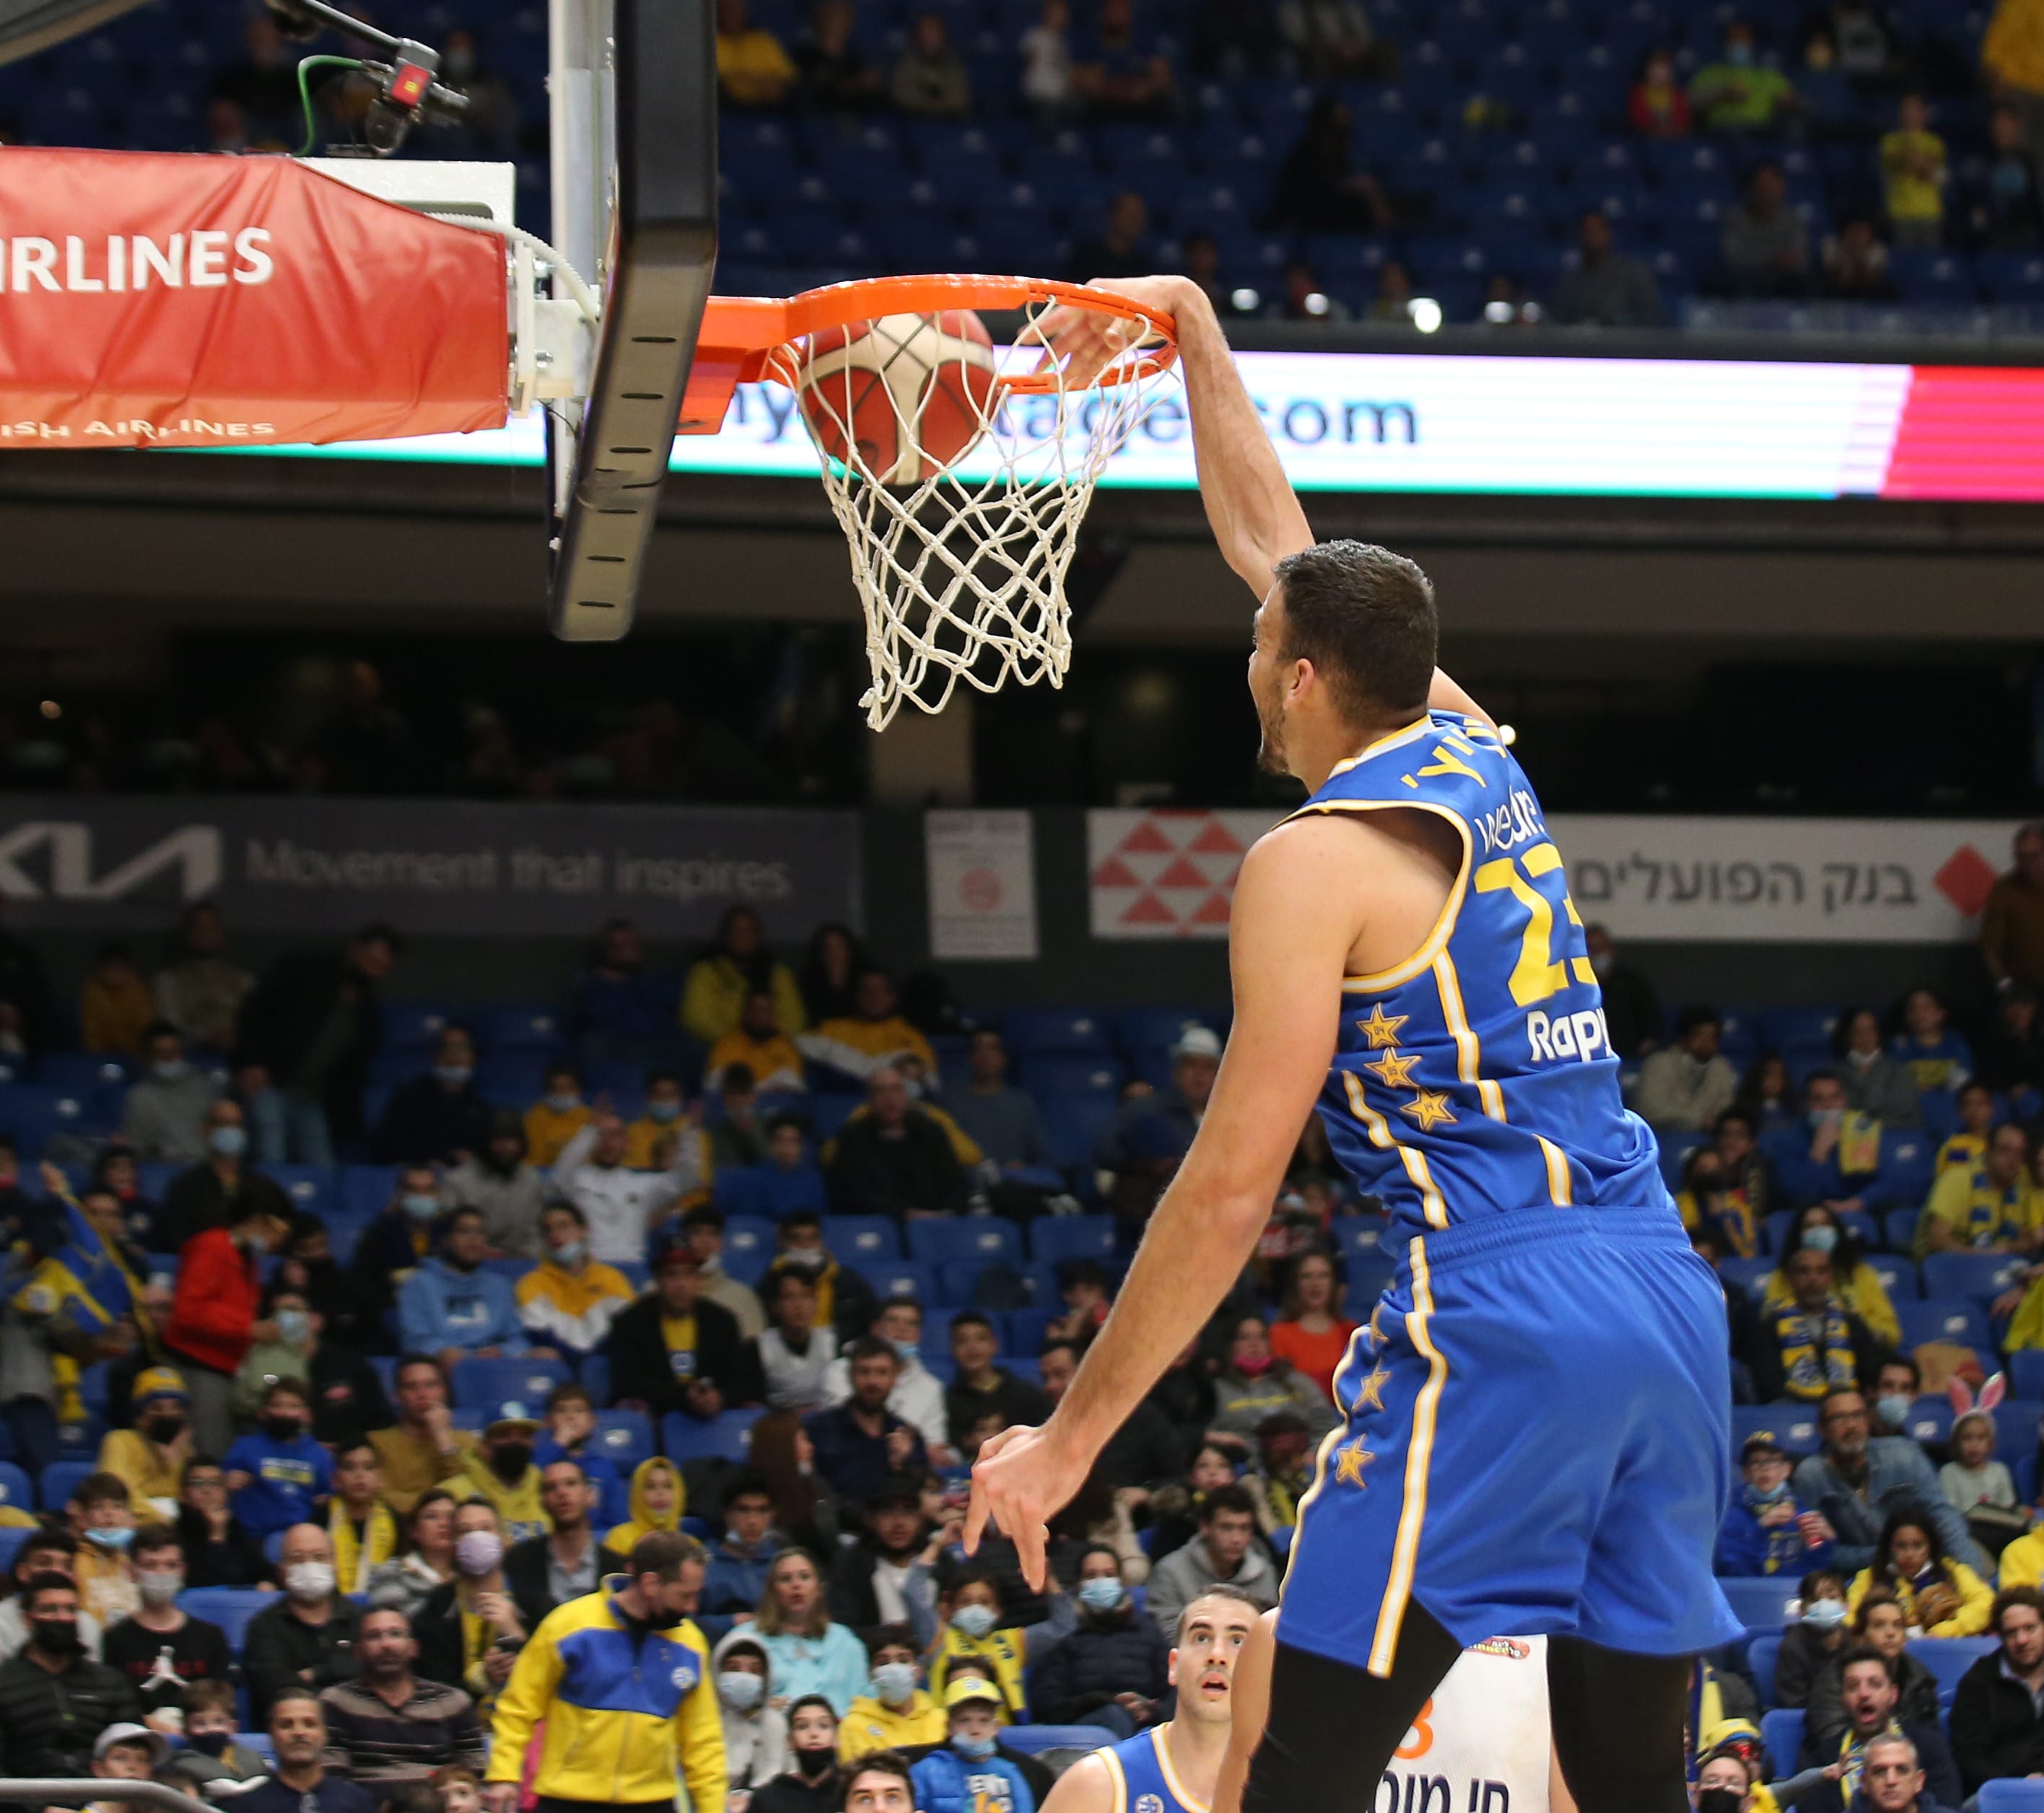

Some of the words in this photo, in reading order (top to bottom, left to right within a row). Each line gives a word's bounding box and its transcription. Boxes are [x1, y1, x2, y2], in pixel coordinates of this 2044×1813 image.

[0, 227, 274, 294] RLINES
[245, 839, 499, 891] Movement
[510, 846, 604, 894] that
[613, 847, 792, 904] inspires
[1573, 849, 1805, 904] הפועלים
[1820, 860, 1918, 915] בנק
